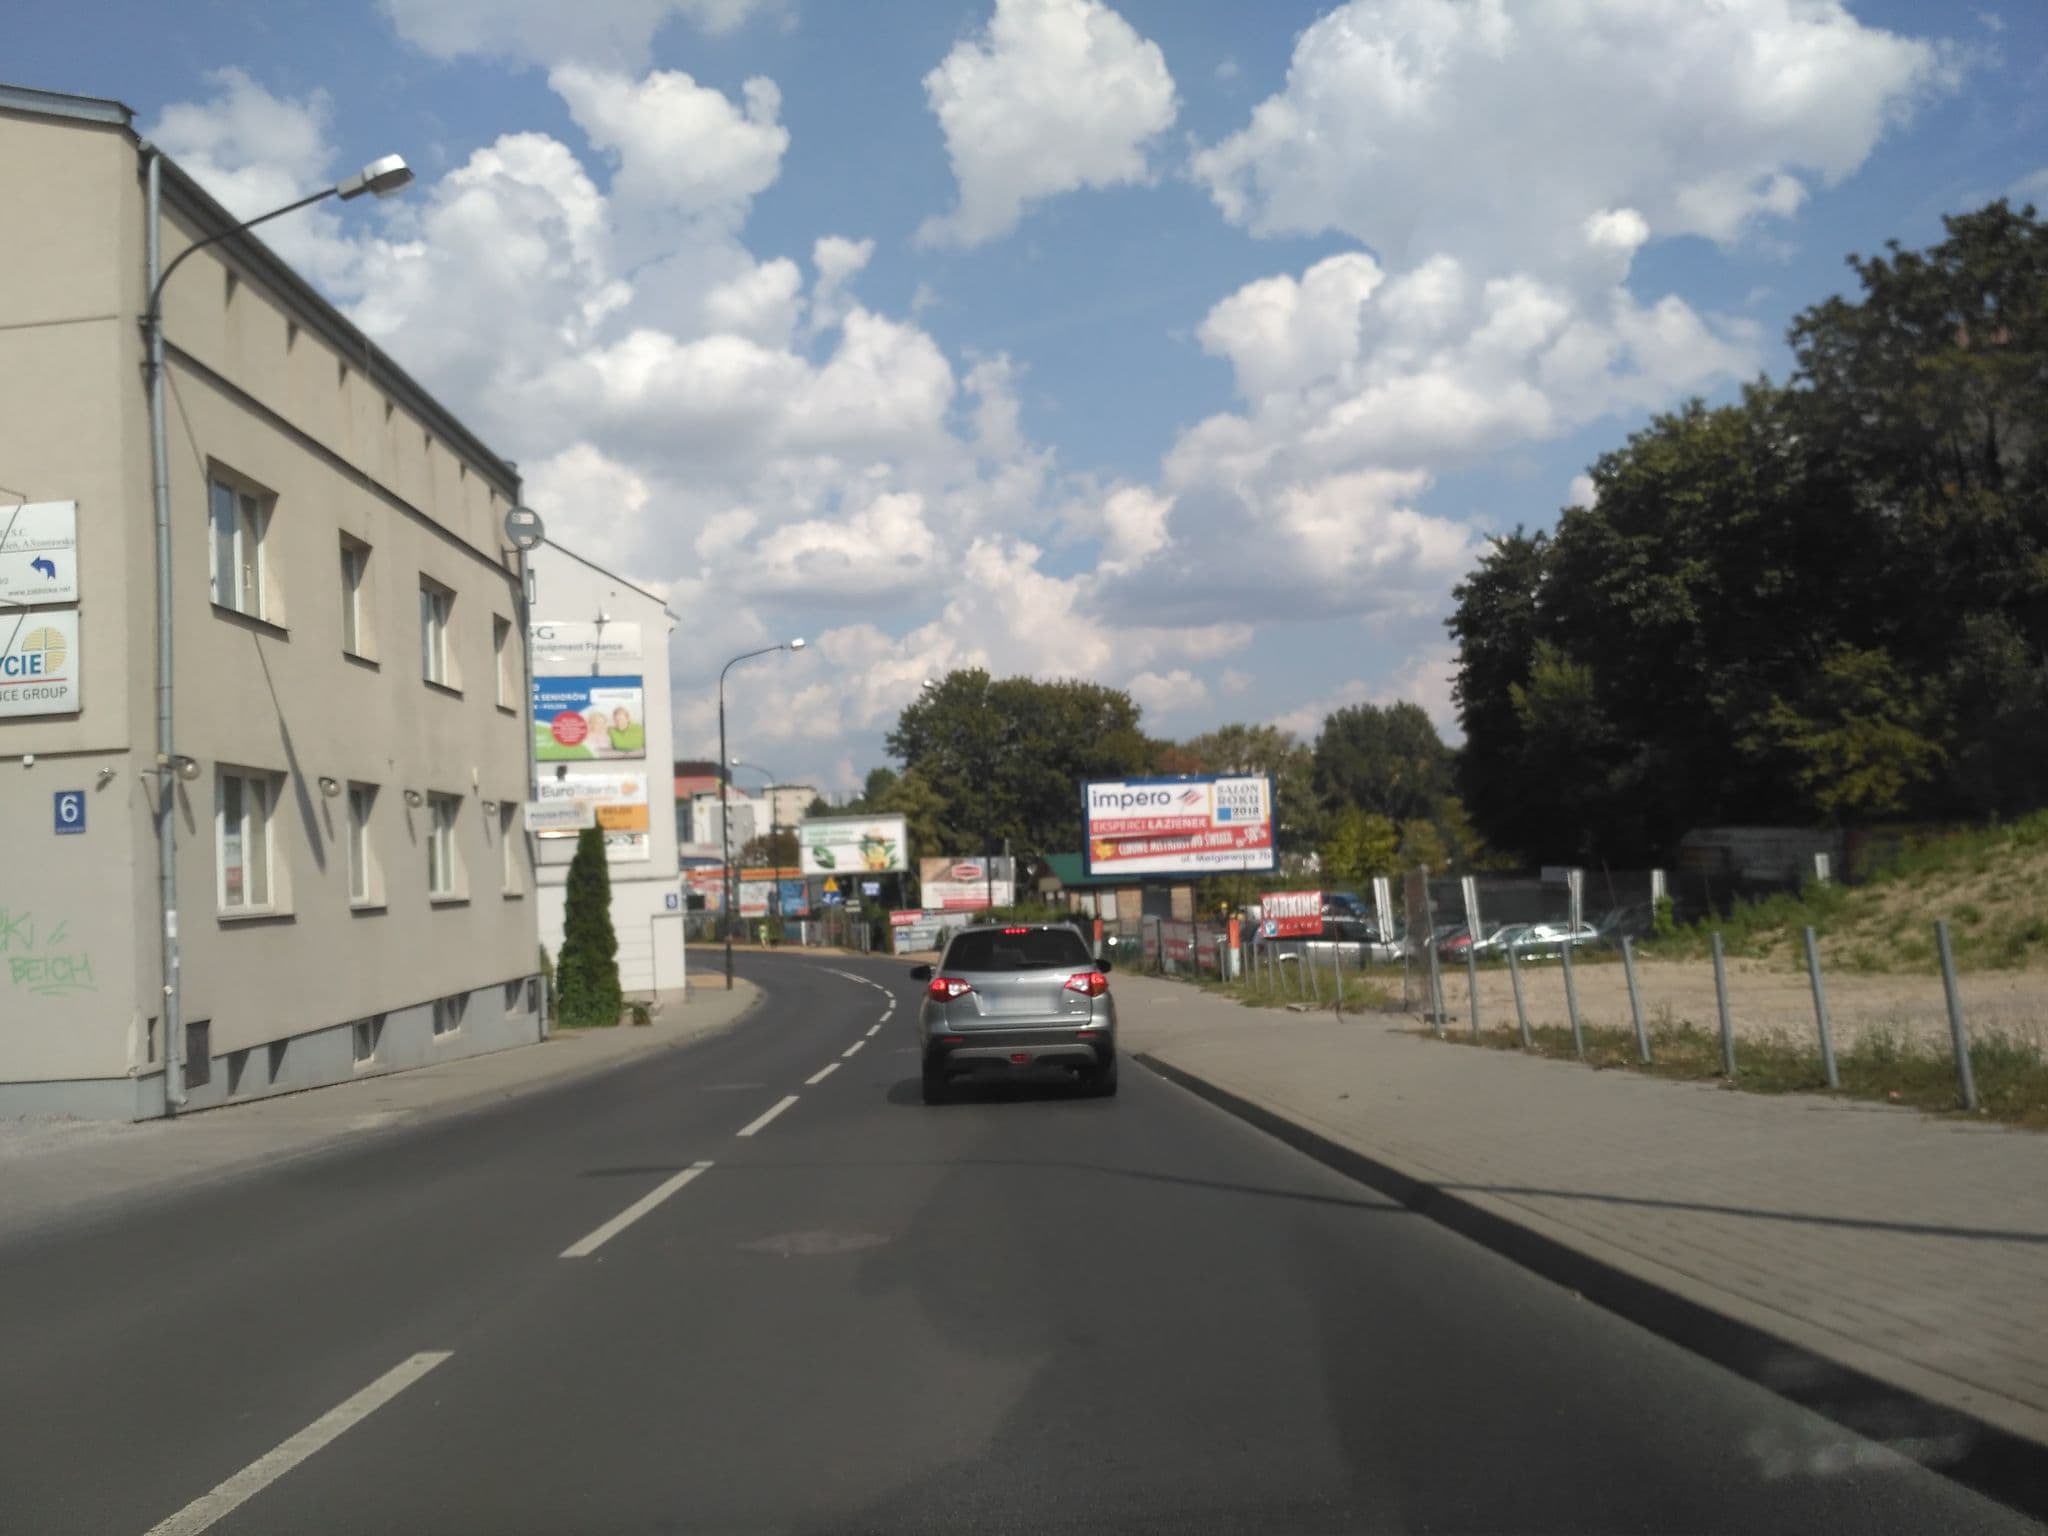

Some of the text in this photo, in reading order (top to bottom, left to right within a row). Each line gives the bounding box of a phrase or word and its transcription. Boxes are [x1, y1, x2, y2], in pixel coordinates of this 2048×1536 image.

[0, 686, 68, 702] CE GROUP
[1217, 783, 1258, 795] SALON
[60, 795, 78, 823] 6
[1092, 789, 1171, 811] impero
[1232, 807, 1259, 817] 2018
[1263, 893, 1320, 918] PARKING
